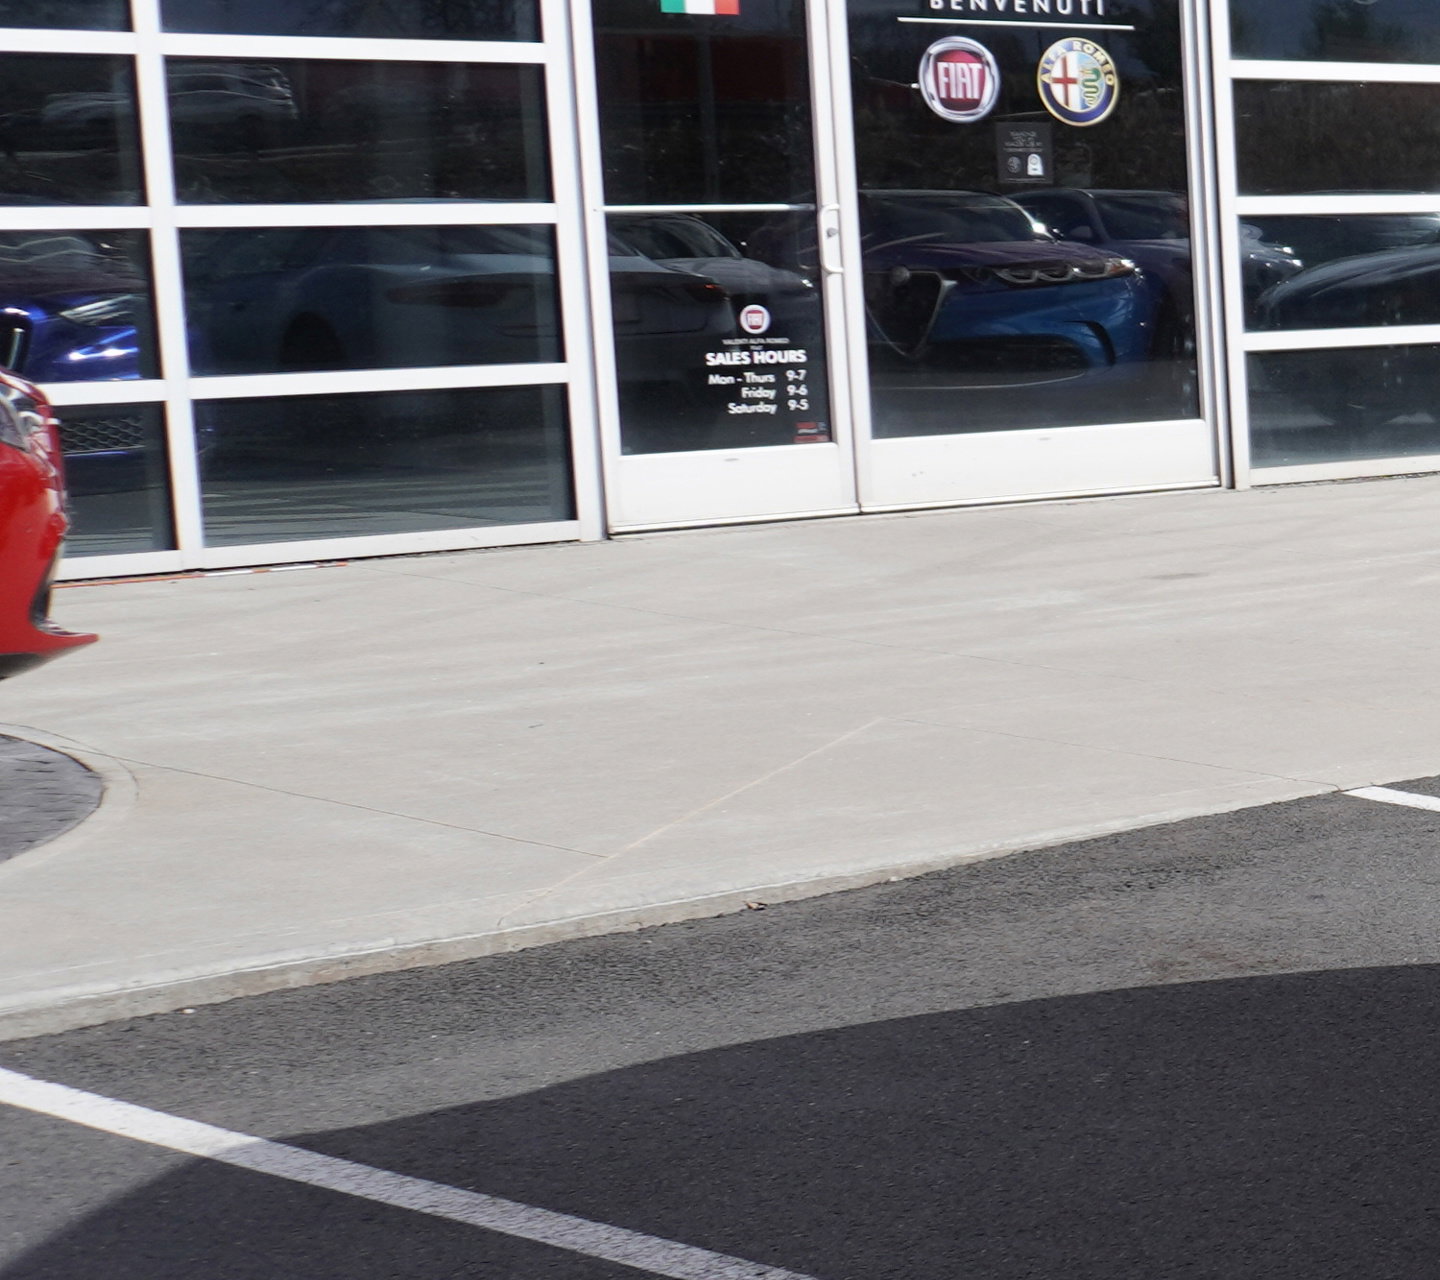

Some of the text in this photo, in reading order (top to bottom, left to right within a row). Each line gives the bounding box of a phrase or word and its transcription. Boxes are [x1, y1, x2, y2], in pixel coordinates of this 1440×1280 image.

[1040, 40, 1114, 86] ALFA ROMEO
[936, 61, 984, 100] FIAT
[705, 349, 807, 366] SALES HOURS
[708, 374, 735, 385] Mon
[743, 372, 775, 383] Thurs
[785, 369, 806, 381] 9-7
[741, 384, 808, 400] Friday 9-6
[728, 399, 809, 415] Saturday 9-5
